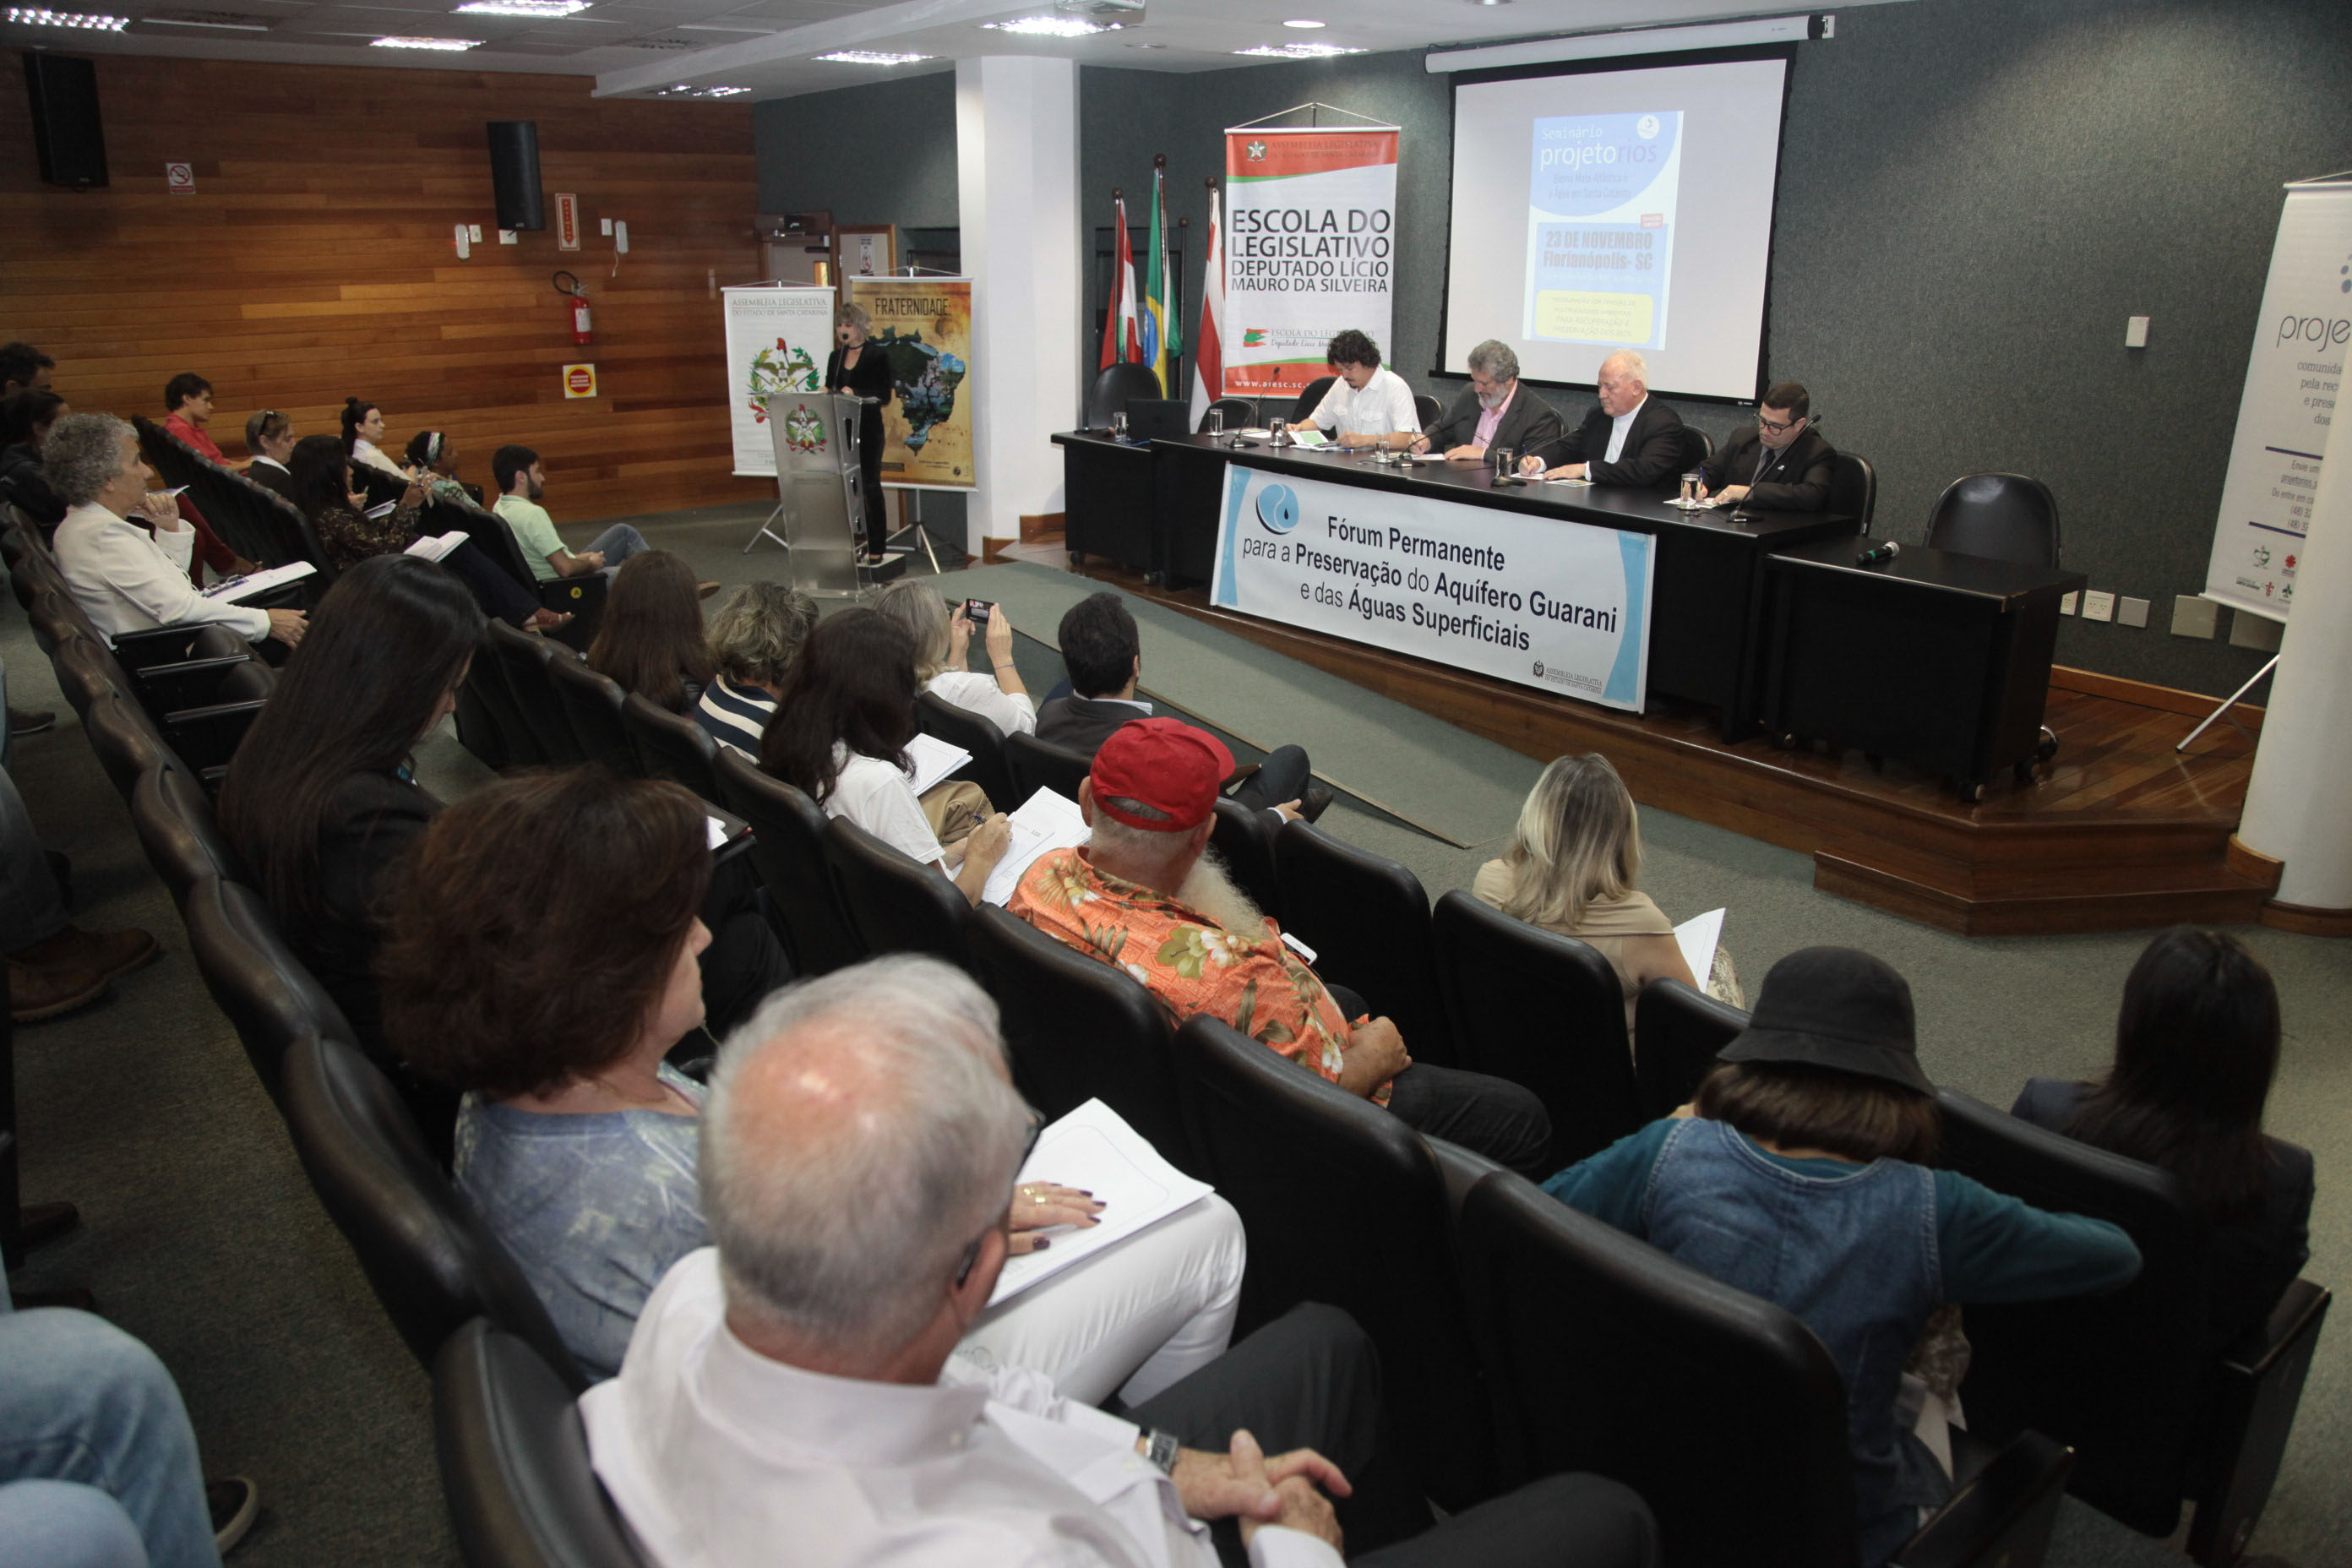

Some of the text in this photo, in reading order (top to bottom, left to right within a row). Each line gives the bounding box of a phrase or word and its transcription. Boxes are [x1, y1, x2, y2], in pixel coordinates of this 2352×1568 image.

[1542, 125, 1603, 140] Seminário
[1233, 209, 1391, 233] ESCOLA DO
[1232, 236, 1390, 258] LEGISLATIVO
[1546, 231, 1653, 250] 23 DE NOVEMBRO
[1232, 258, 1389, 277] DEPUTADO LÍCIO
[1635, 253, 1653, 270] SC
[1232, 278, 1387, 292] MAURO DA SILVEIRA
[732, 297, 826, 306] ASSEMBLEIA LEGISLATIVA
[1271, 329, 1302, 337] ESCOLA
[1304, 329, 1318, 337] DO
[2276, 315, 2351, 352] proje
[2297, 361, 2344, 375] comunida
[2300, 378, 2339, 392] pela rec
[2304, 396, 2311, 406] e
[2314, 413, 2331, 427] dos
[1327, 515, 1505, 571] Fórum Permanente
[1243, 537, 1618, 633] para a Preservação do Aquífero Guarani
[1300, 581, 1530, 651] e das Águas Superficiais
[1574, 674, 1603, 688] LEGISLATIVA
